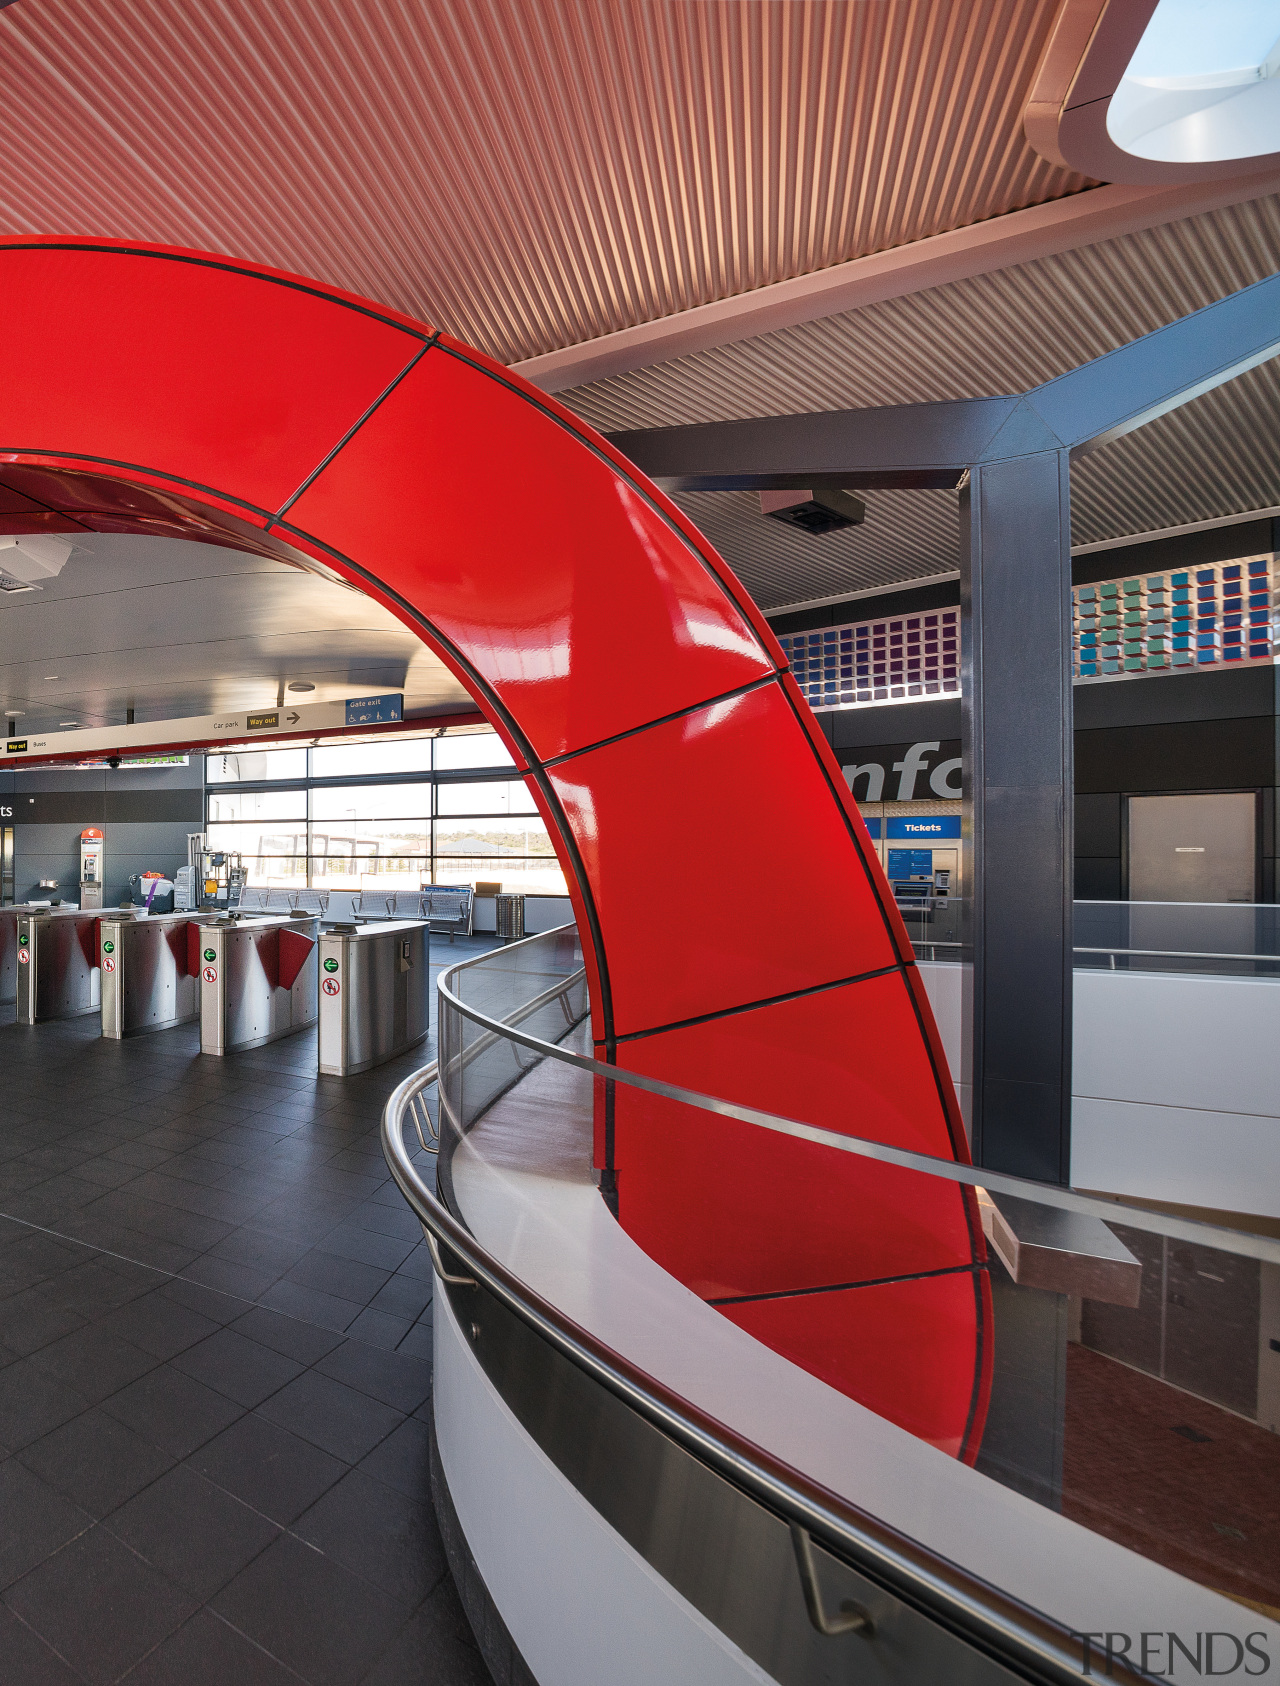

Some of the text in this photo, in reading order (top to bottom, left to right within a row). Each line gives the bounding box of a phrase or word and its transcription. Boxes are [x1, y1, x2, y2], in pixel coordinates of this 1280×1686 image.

[350, 700, 366, 708] Gate
[224, 721, 239, 730] park
[249, 717, 276, 727] Way out
[8, 743, 18, 751] Way
[840, 741, 963, 802] nfo
[904, 823, 942, 832] Tickets
